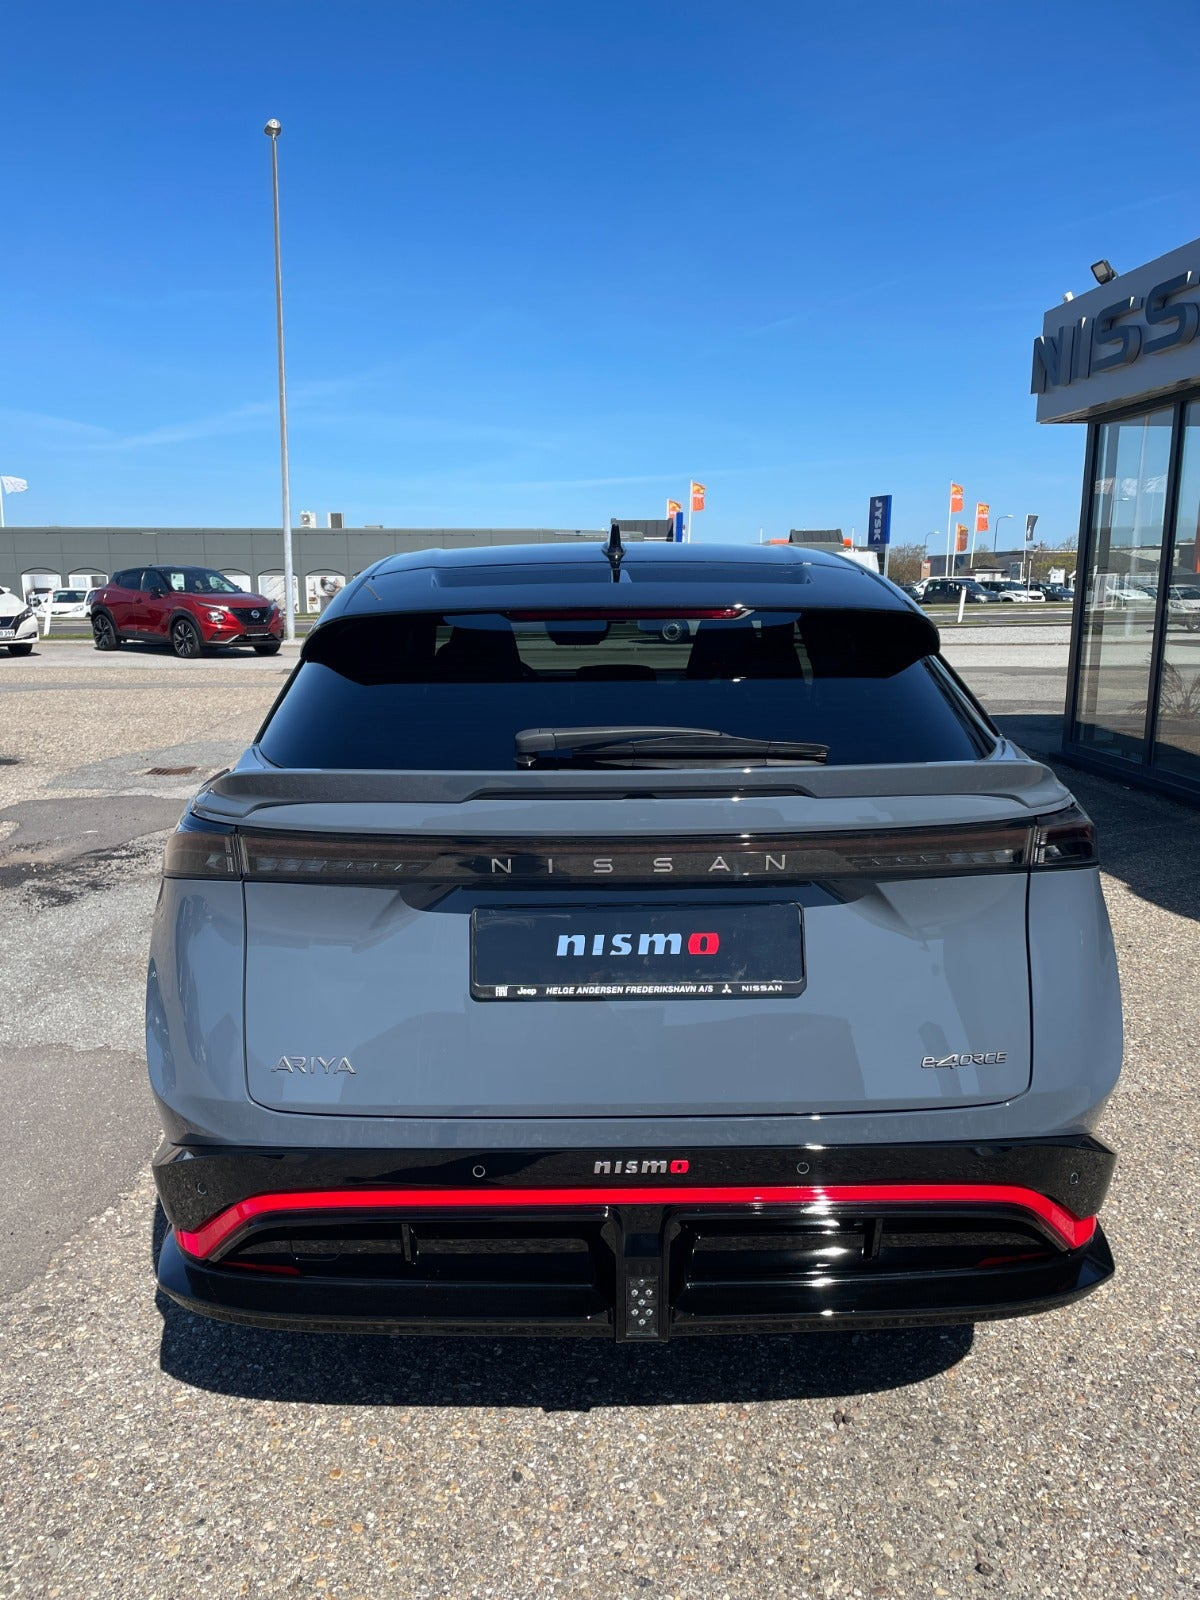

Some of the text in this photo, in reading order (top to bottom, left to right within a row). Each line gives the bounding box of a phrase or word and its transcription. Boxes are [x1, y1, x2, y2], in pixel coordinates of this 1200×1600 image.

[1031, 270, 1200, 394] NISS
[873, 499, 883, 541] JYSK
[491, 854, 787, 874] NISSAN
[556, 932, 720, 956] nismo
[517, 986, 537, 996] Jeep
[546, 986, 575, 995] HELGE
[576, 985, 624, 995] ANDERSEN
[625, 984, 697, 994] FREDERIKSHAVN
[698, 984, 714, 993] A/S
[741, 984, 783, 992] NISSAN
[271, 1055, 357, 1075] ARIYA
[593, 1160, 690, 1174] nismo
